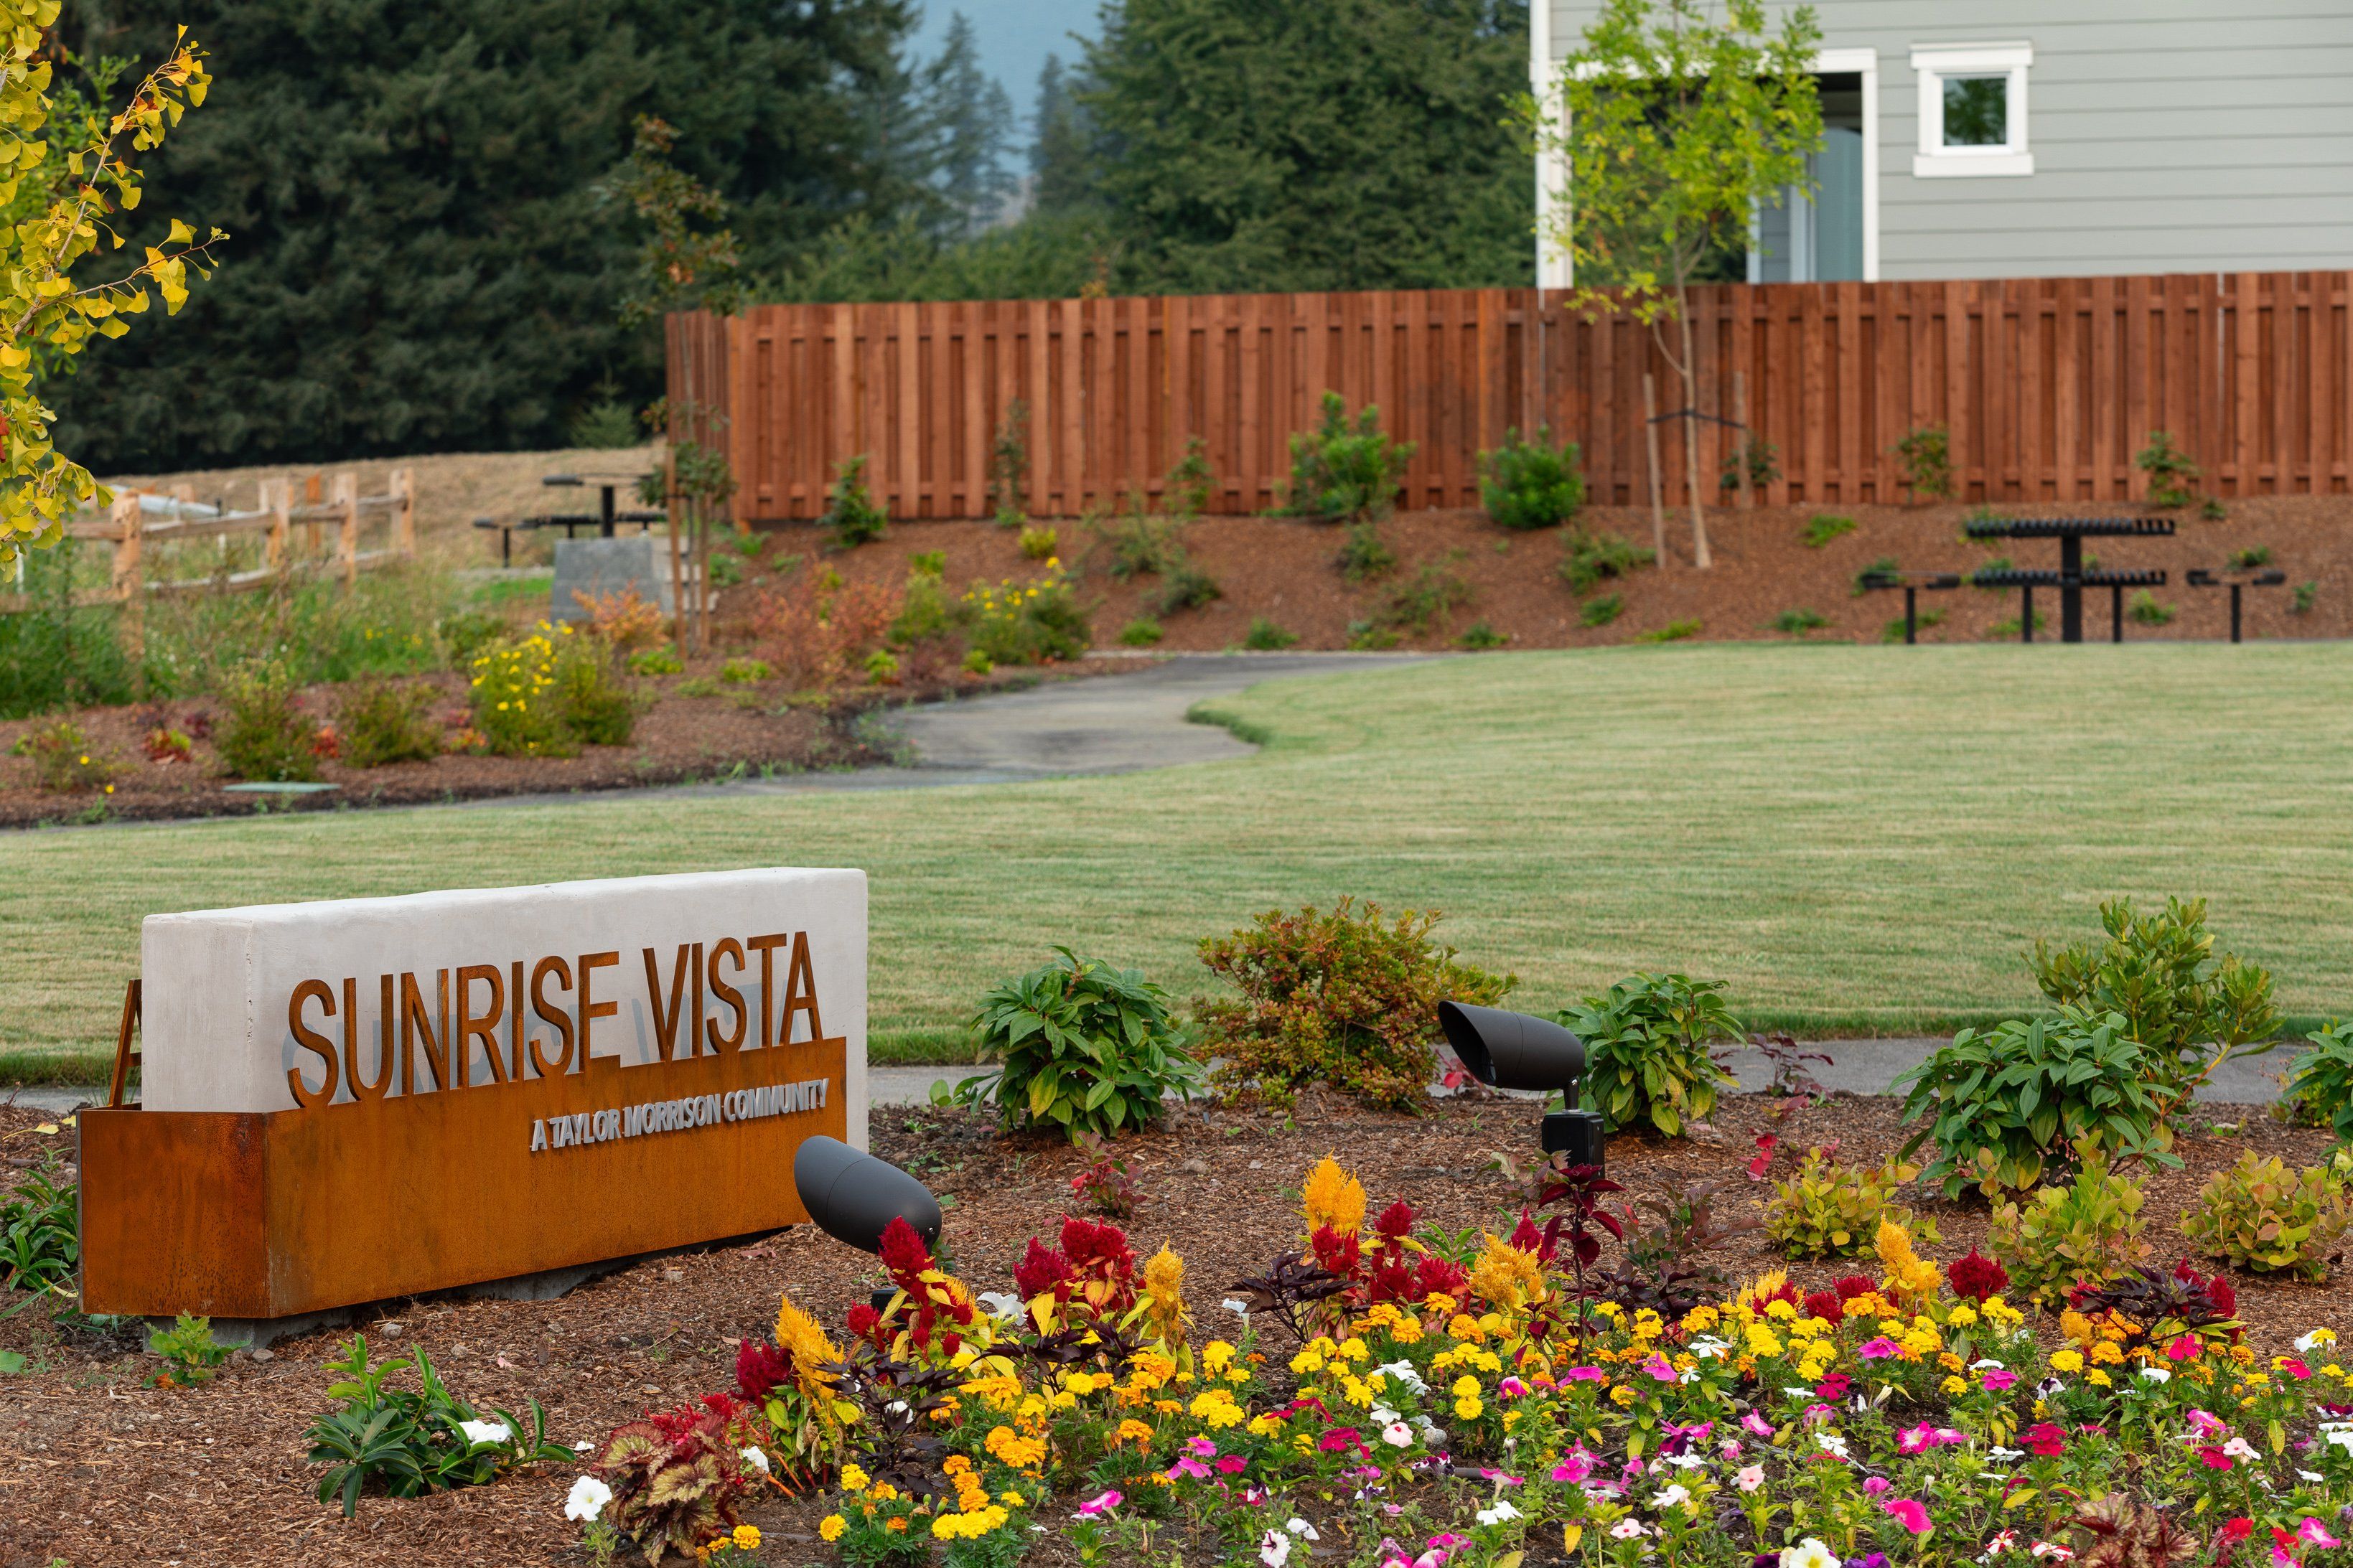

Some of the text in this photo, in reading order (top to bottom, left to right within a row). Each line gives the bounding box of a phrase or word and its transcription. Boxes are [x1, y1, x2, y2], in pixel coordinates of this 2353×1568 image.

[288, 951, 620, 1107] SUNRISE
[642, 931, 823, 1061] VISTA
[531, 1079, 829, 1151] A TAYLOR MORRISON COMMUNITY
